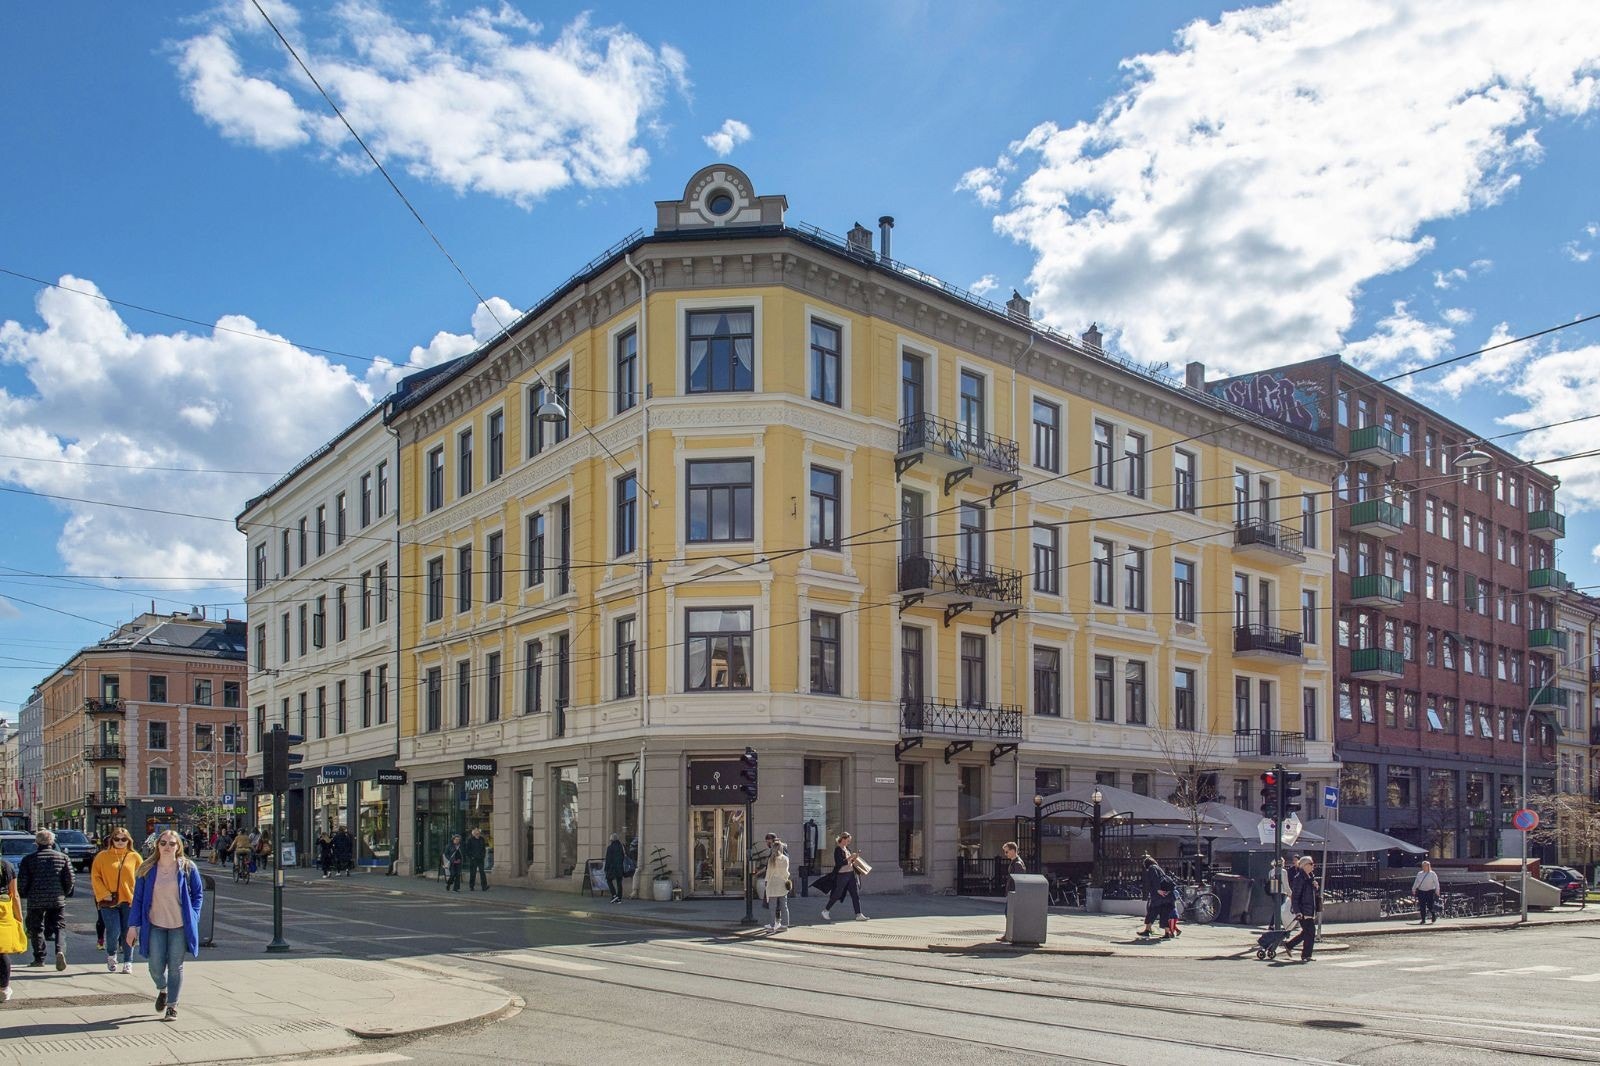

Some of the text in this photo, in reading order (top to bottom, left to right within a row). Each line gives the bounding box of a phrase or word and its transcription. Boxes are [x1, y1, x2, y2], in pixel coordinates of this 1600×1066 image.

[325, 768, 346, 776] norli
[465, 778, 489, 791] MORRIS
[225, 795, 231, 804] P
[101, 807, 112, 815] ARK
[153, 806, 166, 814] ARK
[1046, 800, 1090, 814] HIGHBURY
